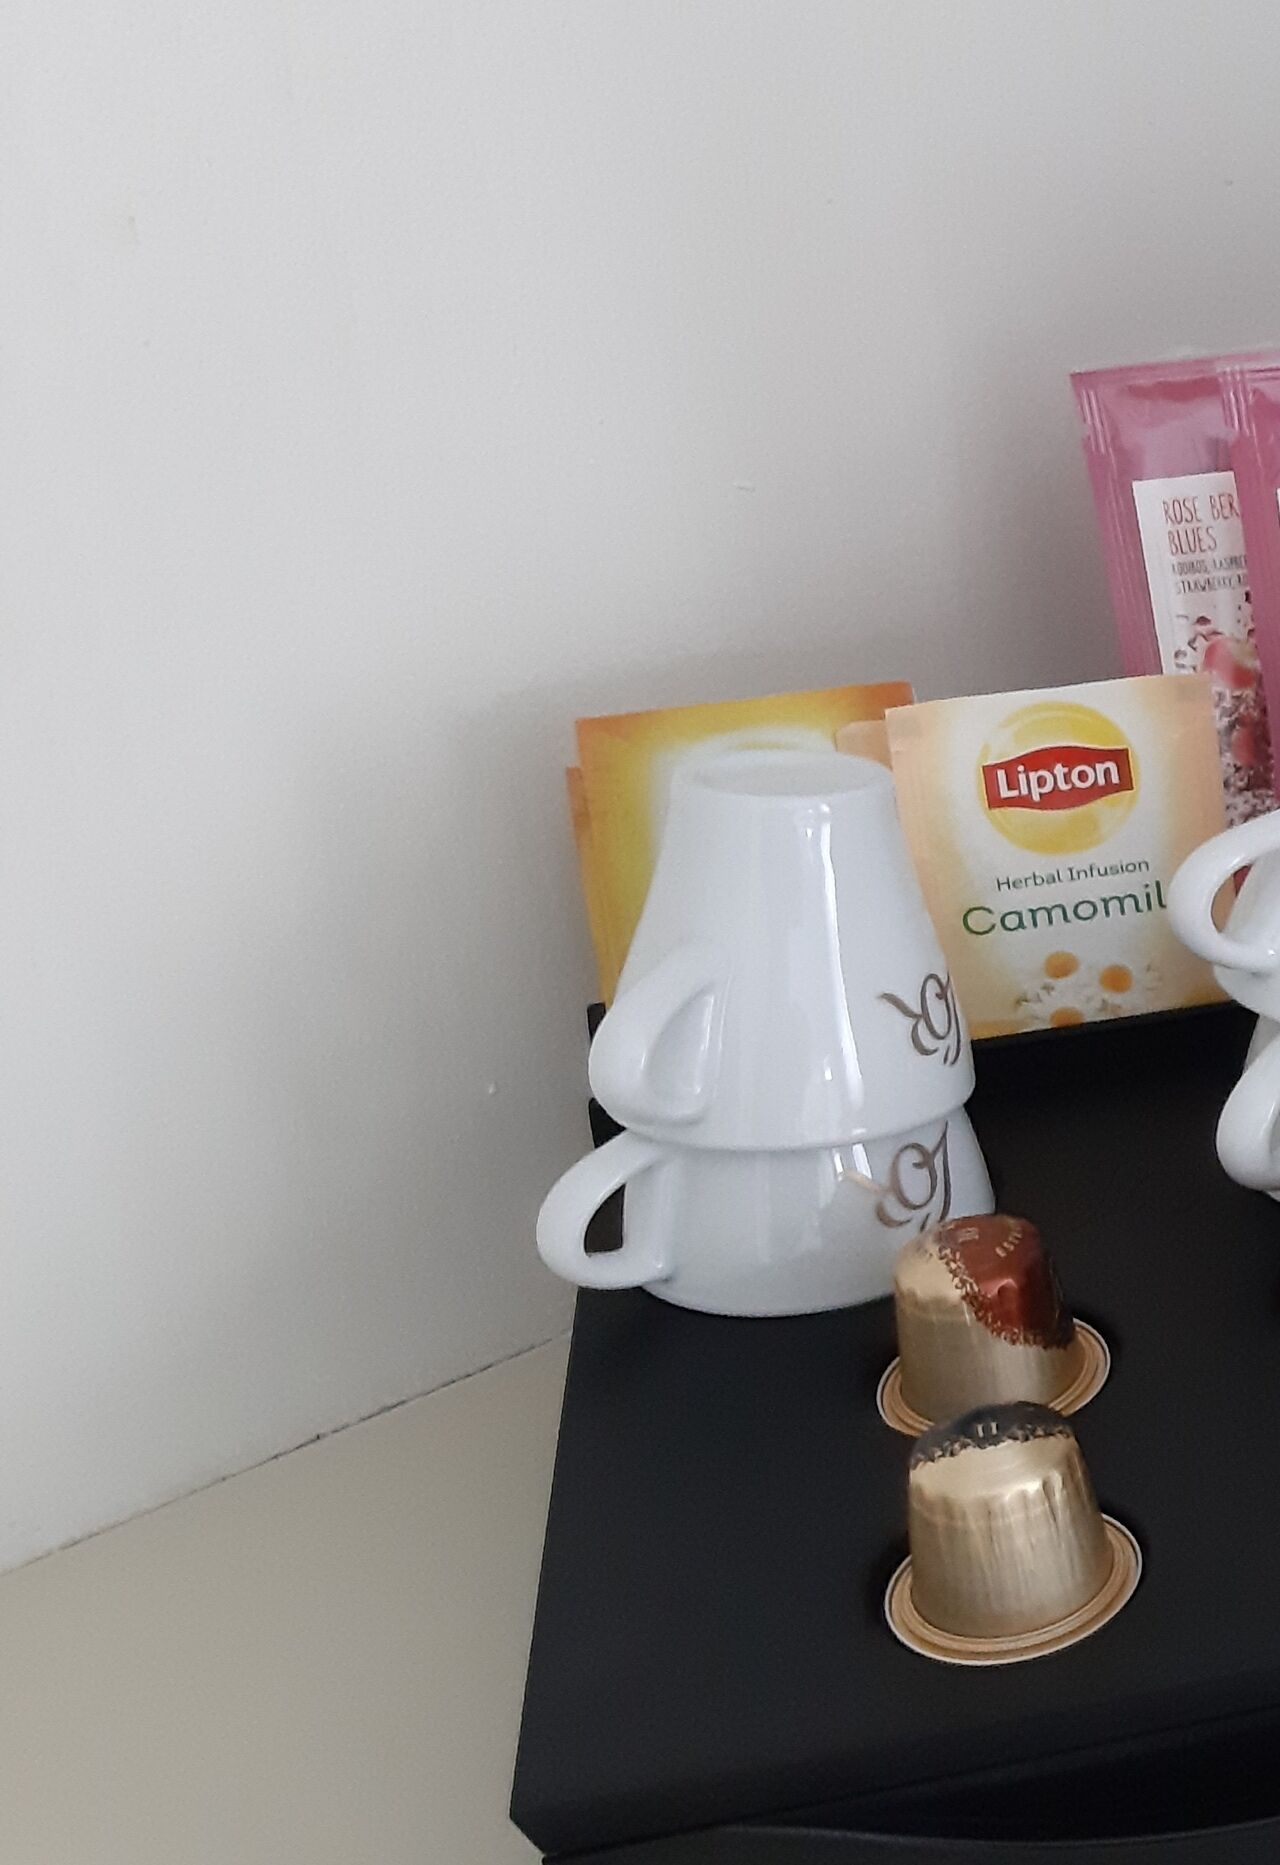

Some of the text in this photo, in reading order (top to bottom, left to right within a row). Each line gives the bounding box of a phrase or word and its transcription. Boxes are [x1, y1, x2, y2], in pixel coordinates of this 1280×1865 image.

[1162, 493, 1241, 524] ROSE BER
[1167, 526, 1218, 556] BLUES
[996, 760, 1121, 803] Lipton
[996, 859, 1151, 892] Herbal Infusion
[961, 880, 1168, 936] Camomil
